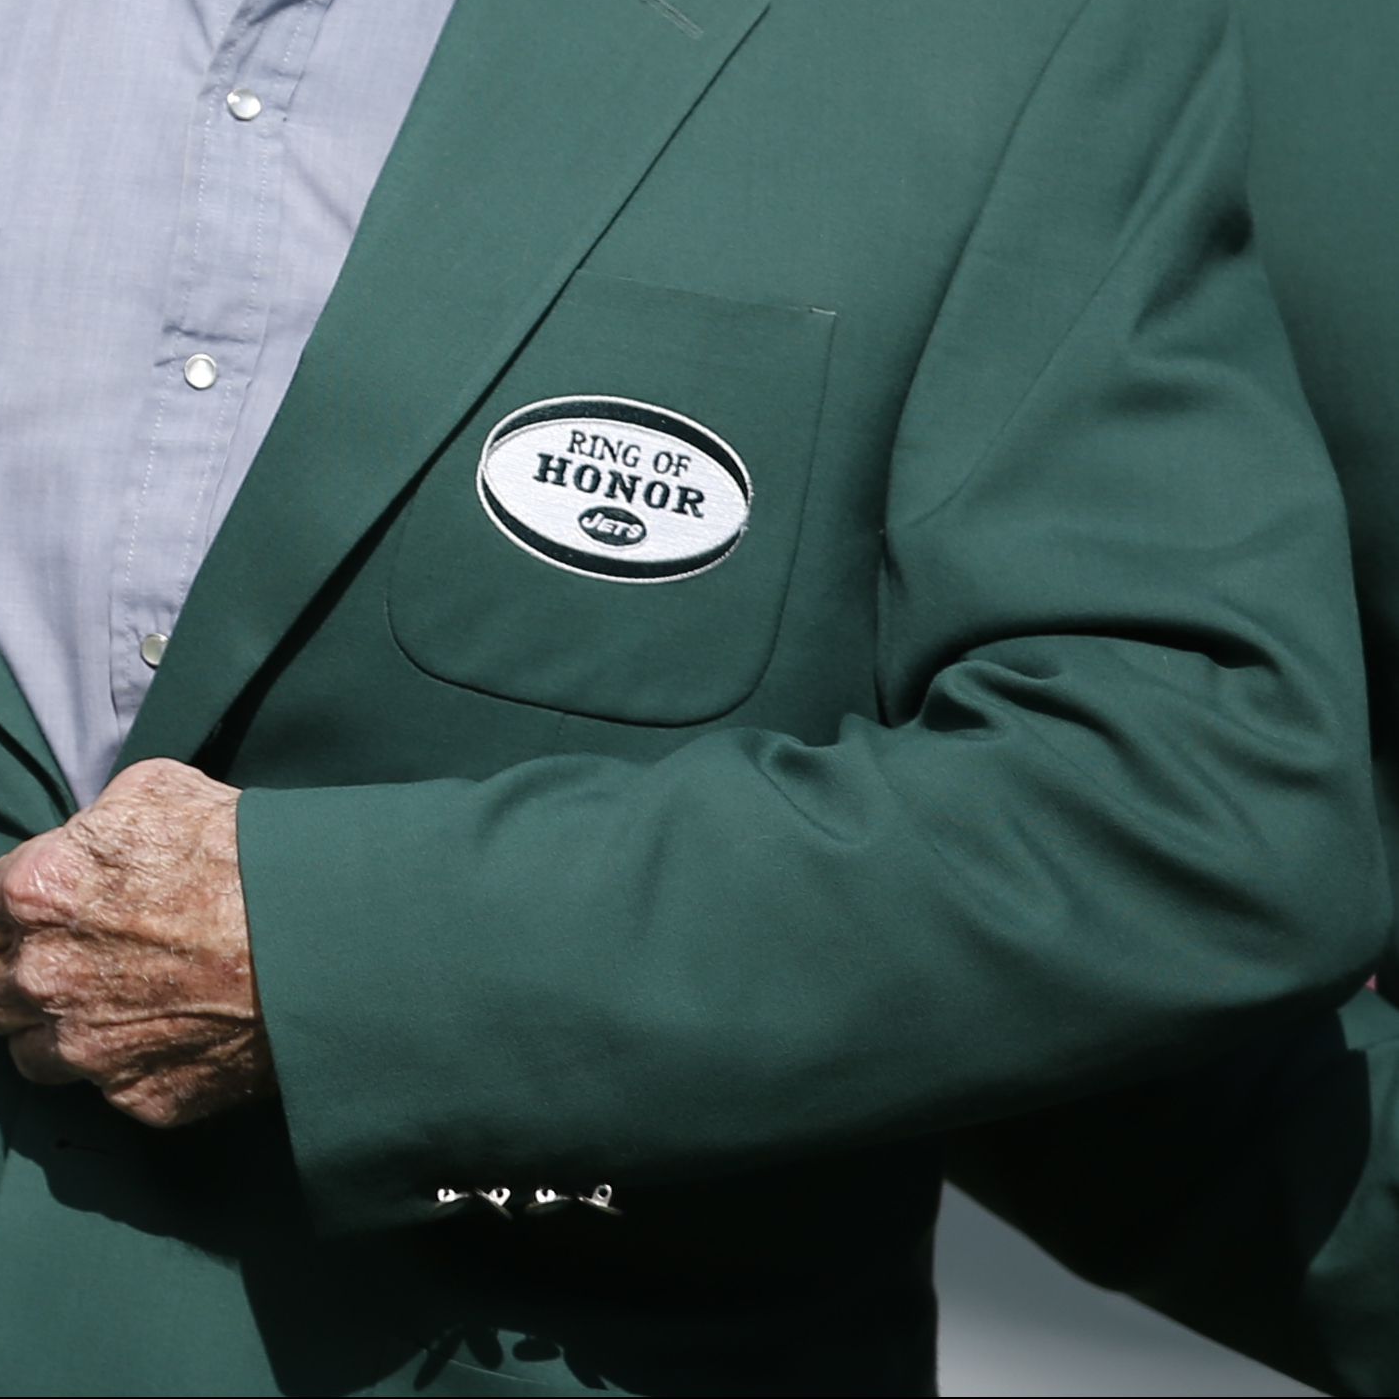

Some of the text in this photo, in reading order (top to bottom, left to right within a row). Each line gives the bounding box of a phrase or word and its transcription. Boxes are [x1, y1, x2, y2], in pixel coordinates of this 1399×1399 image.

[567, 429, 691, 477] RING OF
[532, 452, 705, 519] HONOR
[581, 512, 643, 539] JETS
